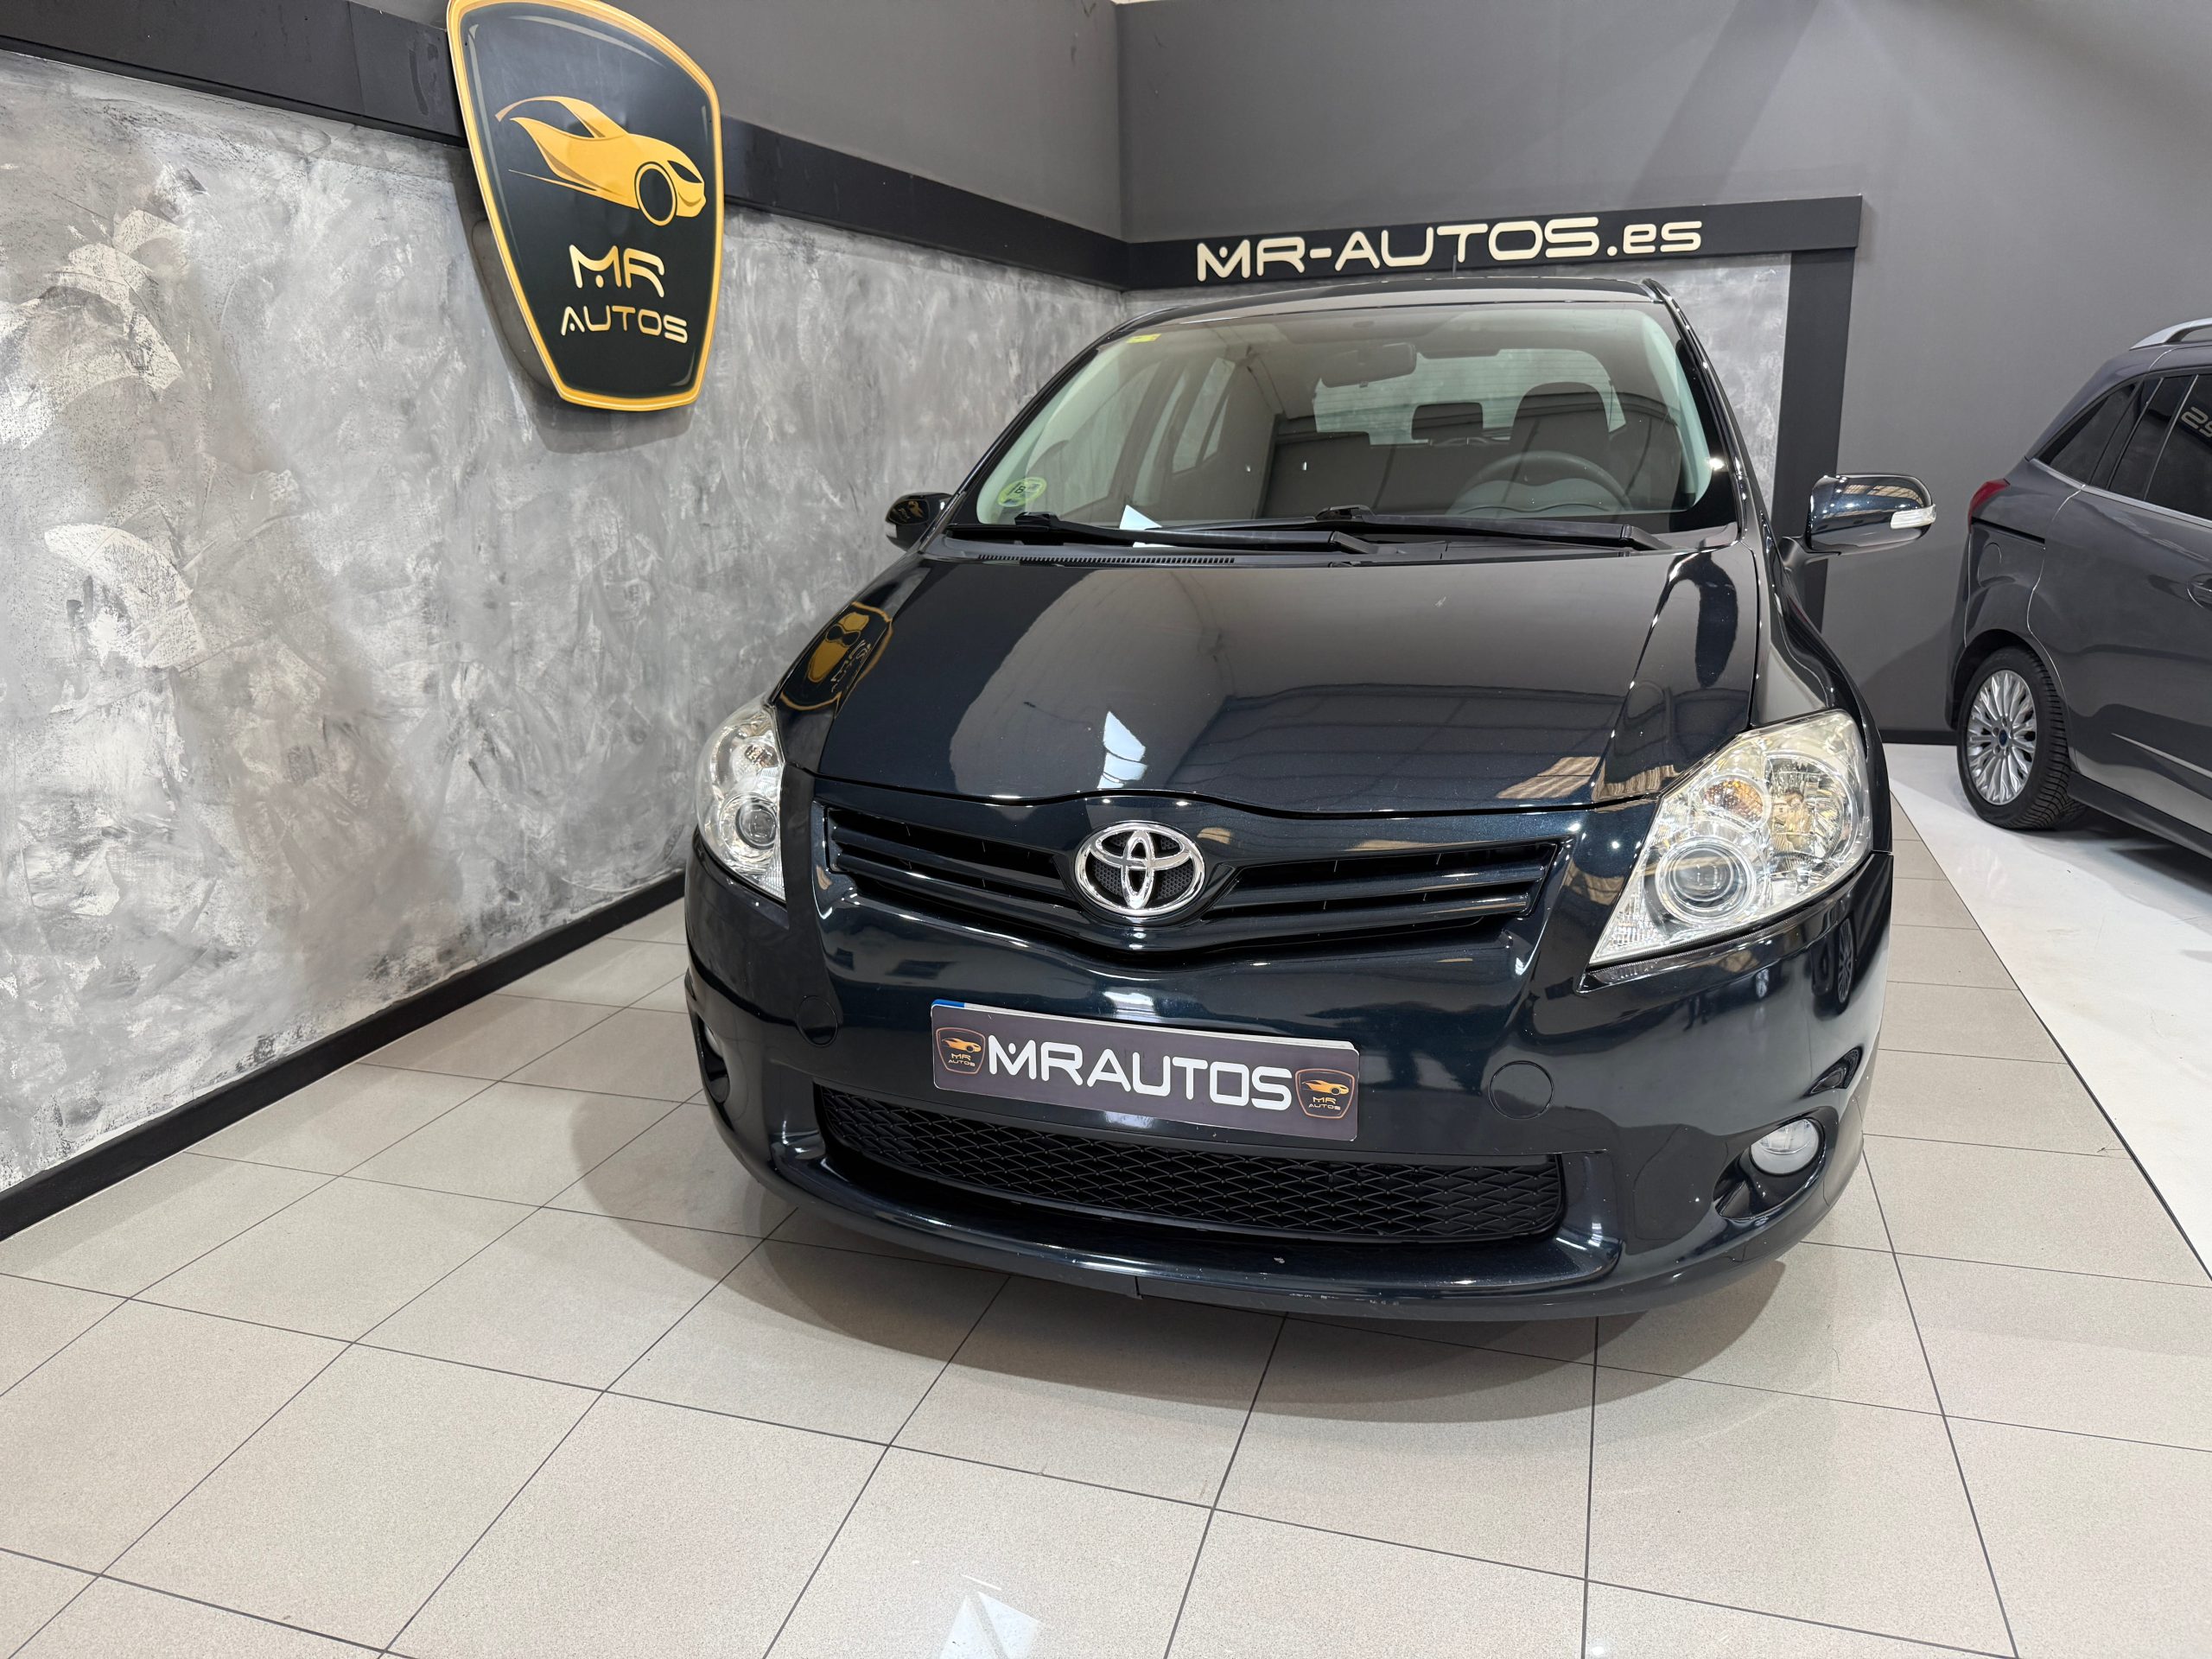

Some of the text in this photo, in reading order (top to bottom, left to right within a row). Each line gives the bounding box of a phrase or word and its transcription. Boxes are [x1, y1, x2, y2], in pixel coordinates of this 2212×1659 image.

[568, 244, 665, 298] MR
[1197, 216, 1702, 282] MR-AUTOS.es
[560, 305, 688, 344] AUTOS
